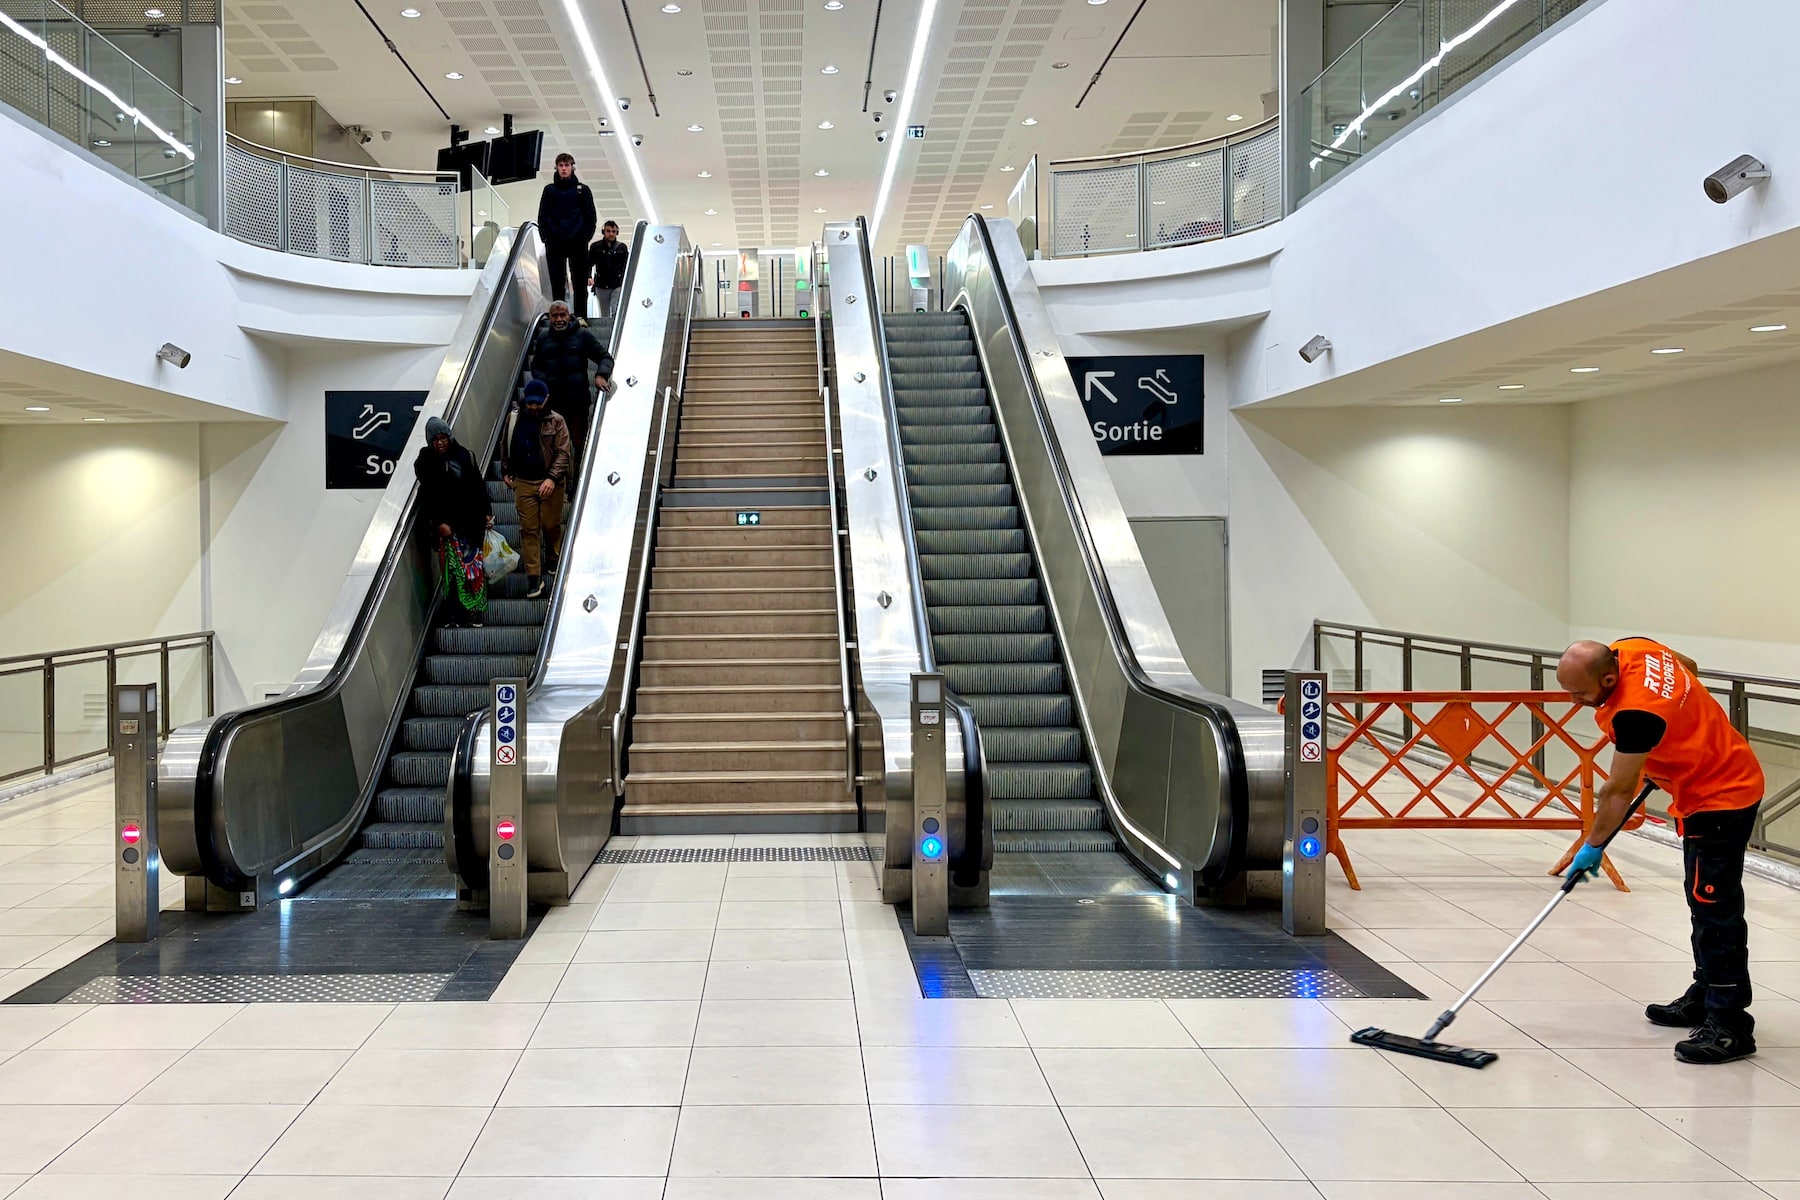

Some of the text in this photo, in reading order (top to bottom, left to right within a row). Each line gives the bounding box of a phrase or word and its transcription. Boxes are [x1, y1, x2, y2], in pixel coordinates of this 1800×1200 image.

[1093, 420, 1163, 441] Sortie
[366, 454, 399, 475] So
[245, 895, 251, 903] 2
